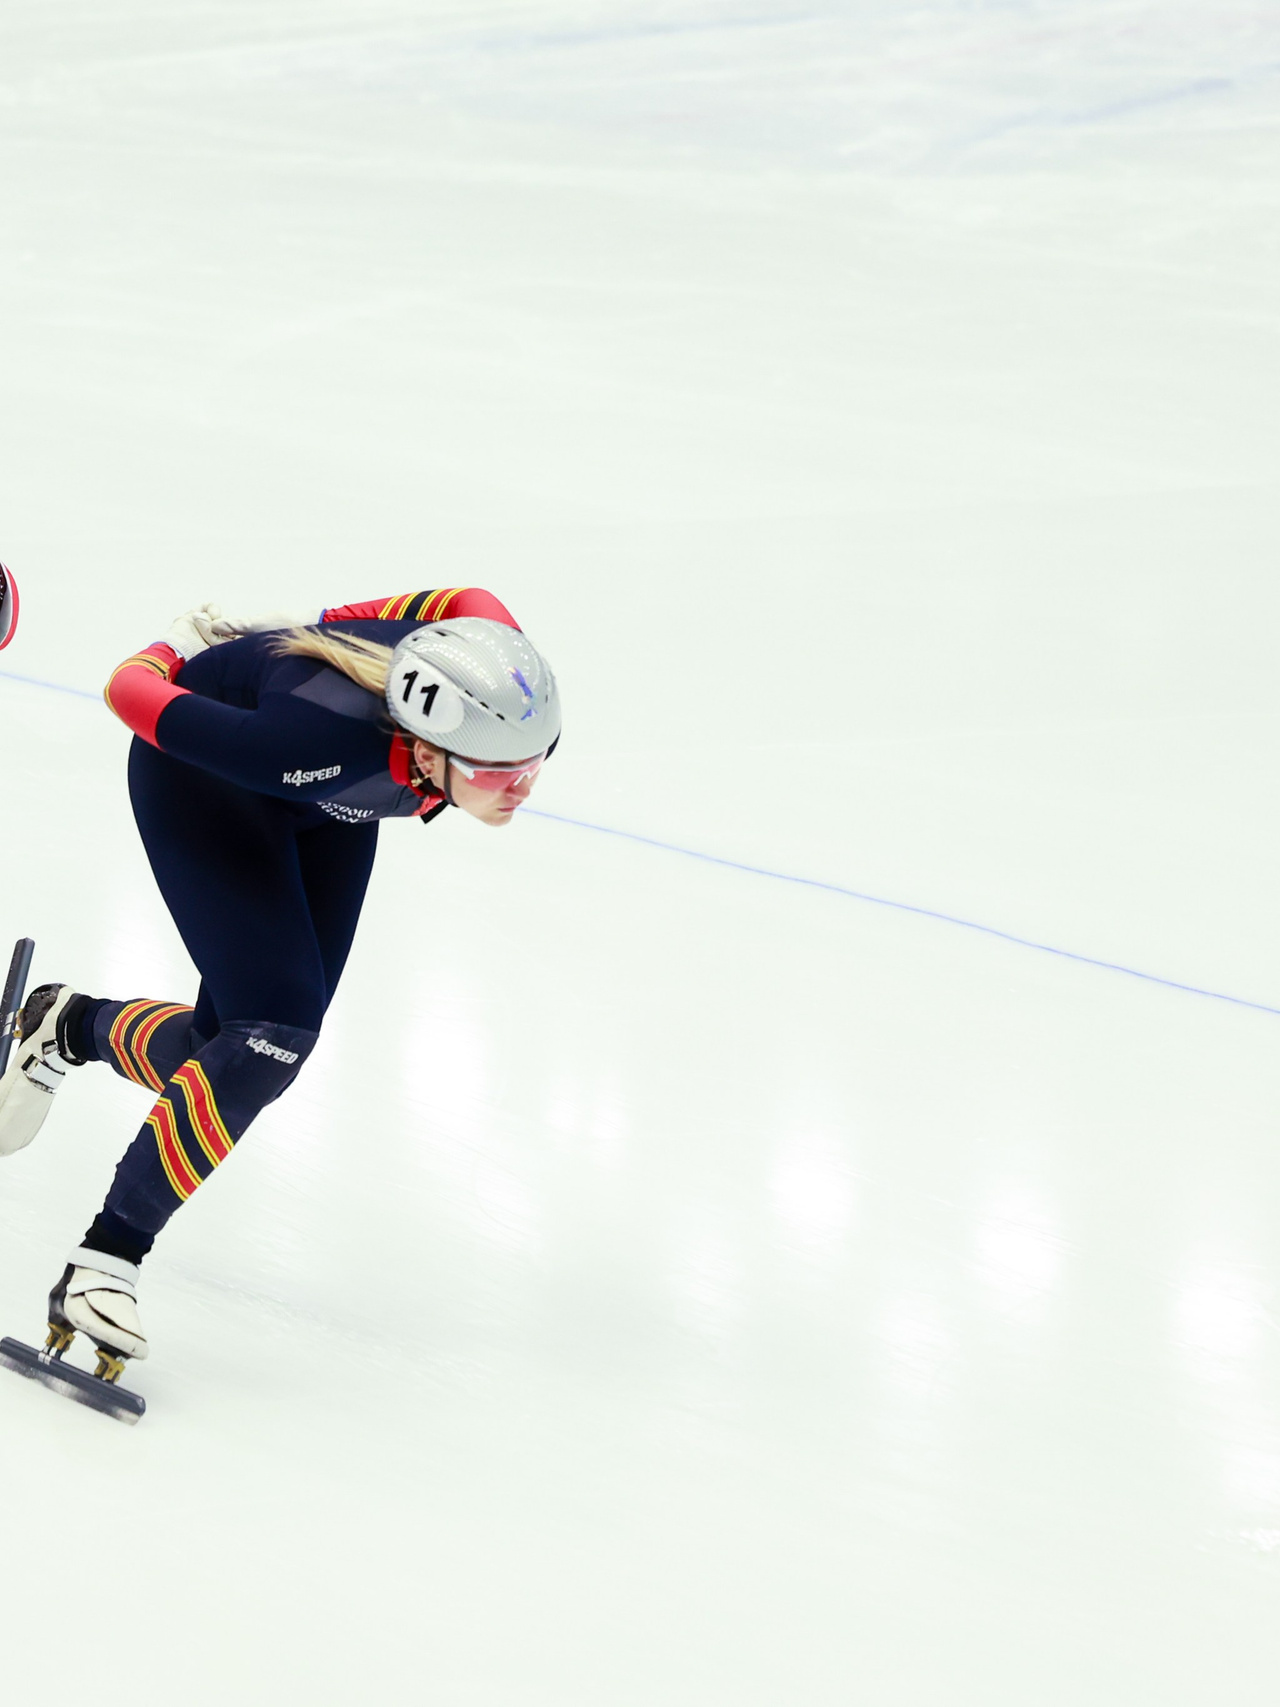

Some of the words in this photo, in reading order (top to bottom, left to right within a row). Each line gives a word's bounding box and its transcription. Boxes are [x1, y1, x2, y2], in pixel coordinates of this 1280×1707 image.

[402, 670, 440, 718] 11
[282, 765, 342, 787] K4SPEED
[245, 1036, 299, 1064] K4SPEED
